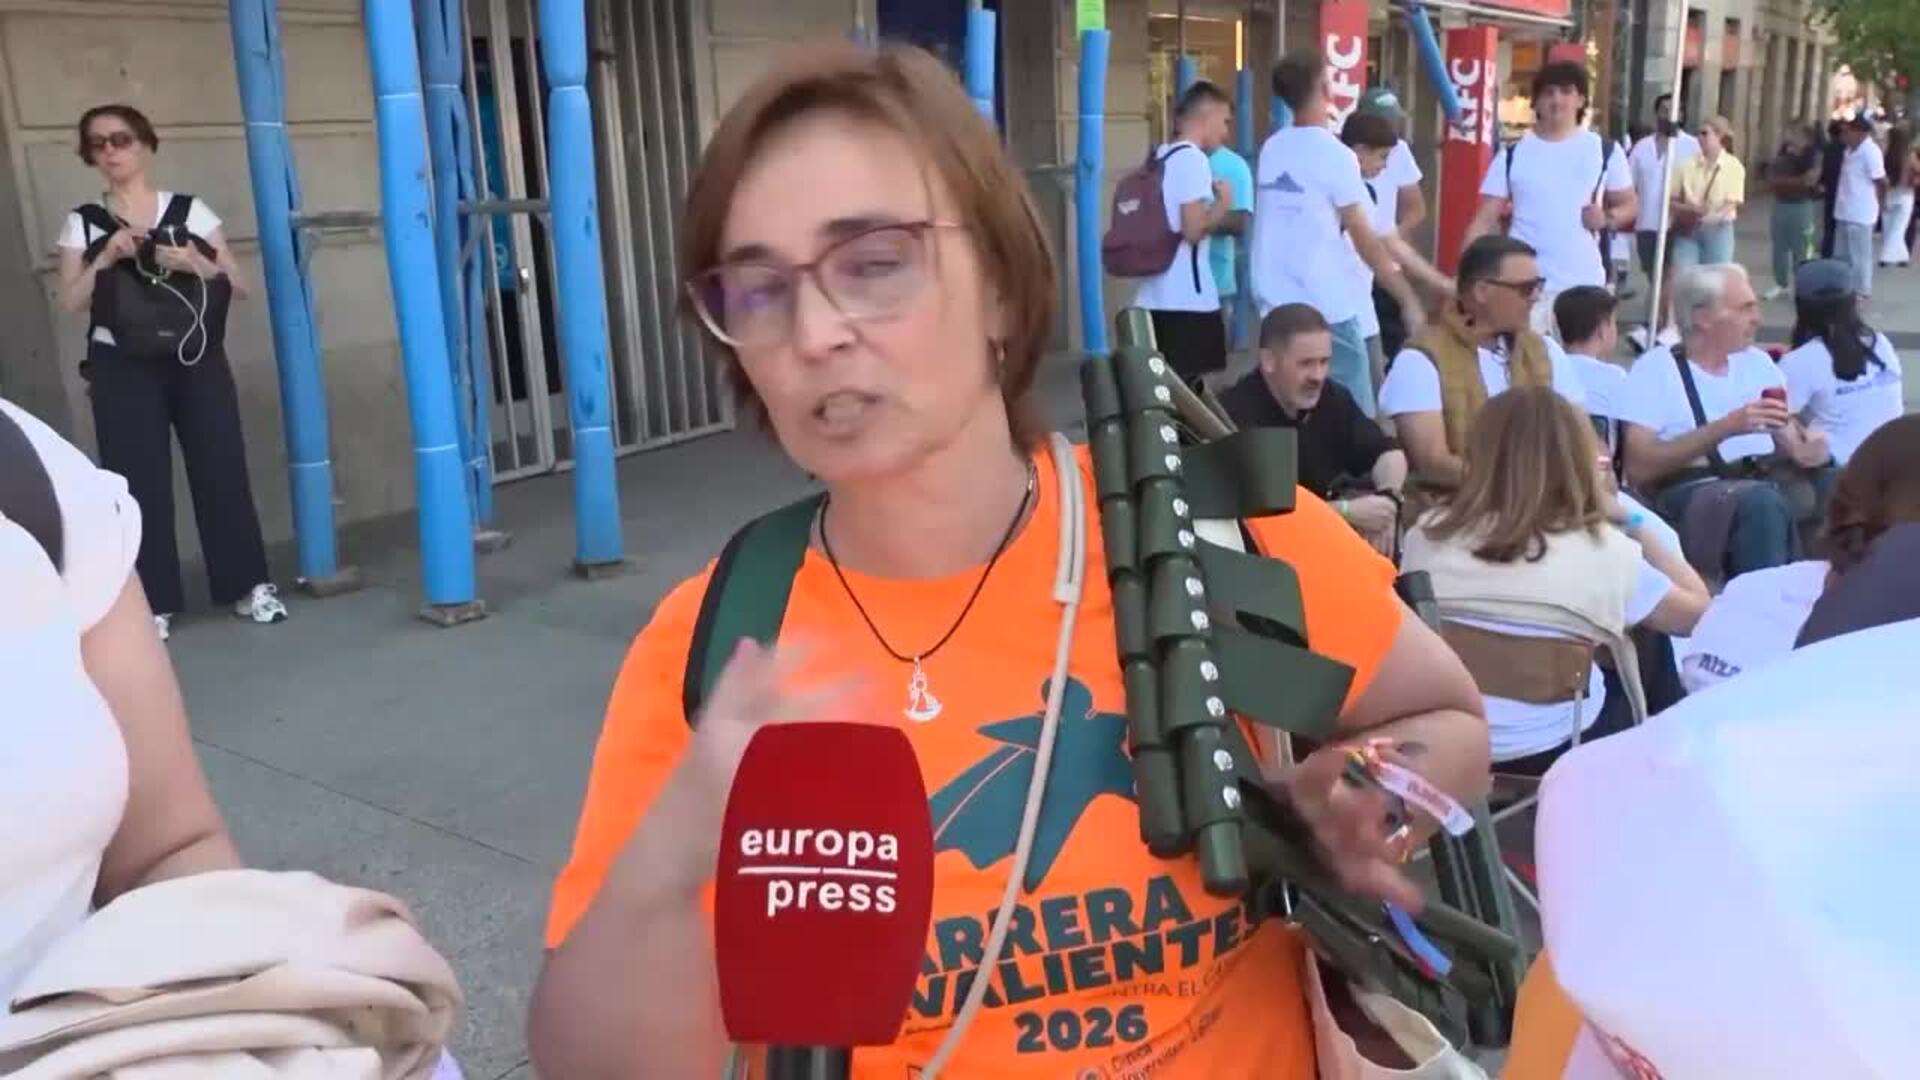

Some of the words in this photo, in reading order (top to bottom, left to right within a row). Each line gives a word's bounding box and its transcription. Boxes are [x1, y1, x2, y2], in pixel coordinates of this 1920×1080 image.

[1326, 33, 1362, 135] KFC
[740, 828, 898, 866] europa
[767, 879, 896, 917] press
[906, 875, 1195, 977] RRERA
[1014, 1004, 1148, 1054] 2026
